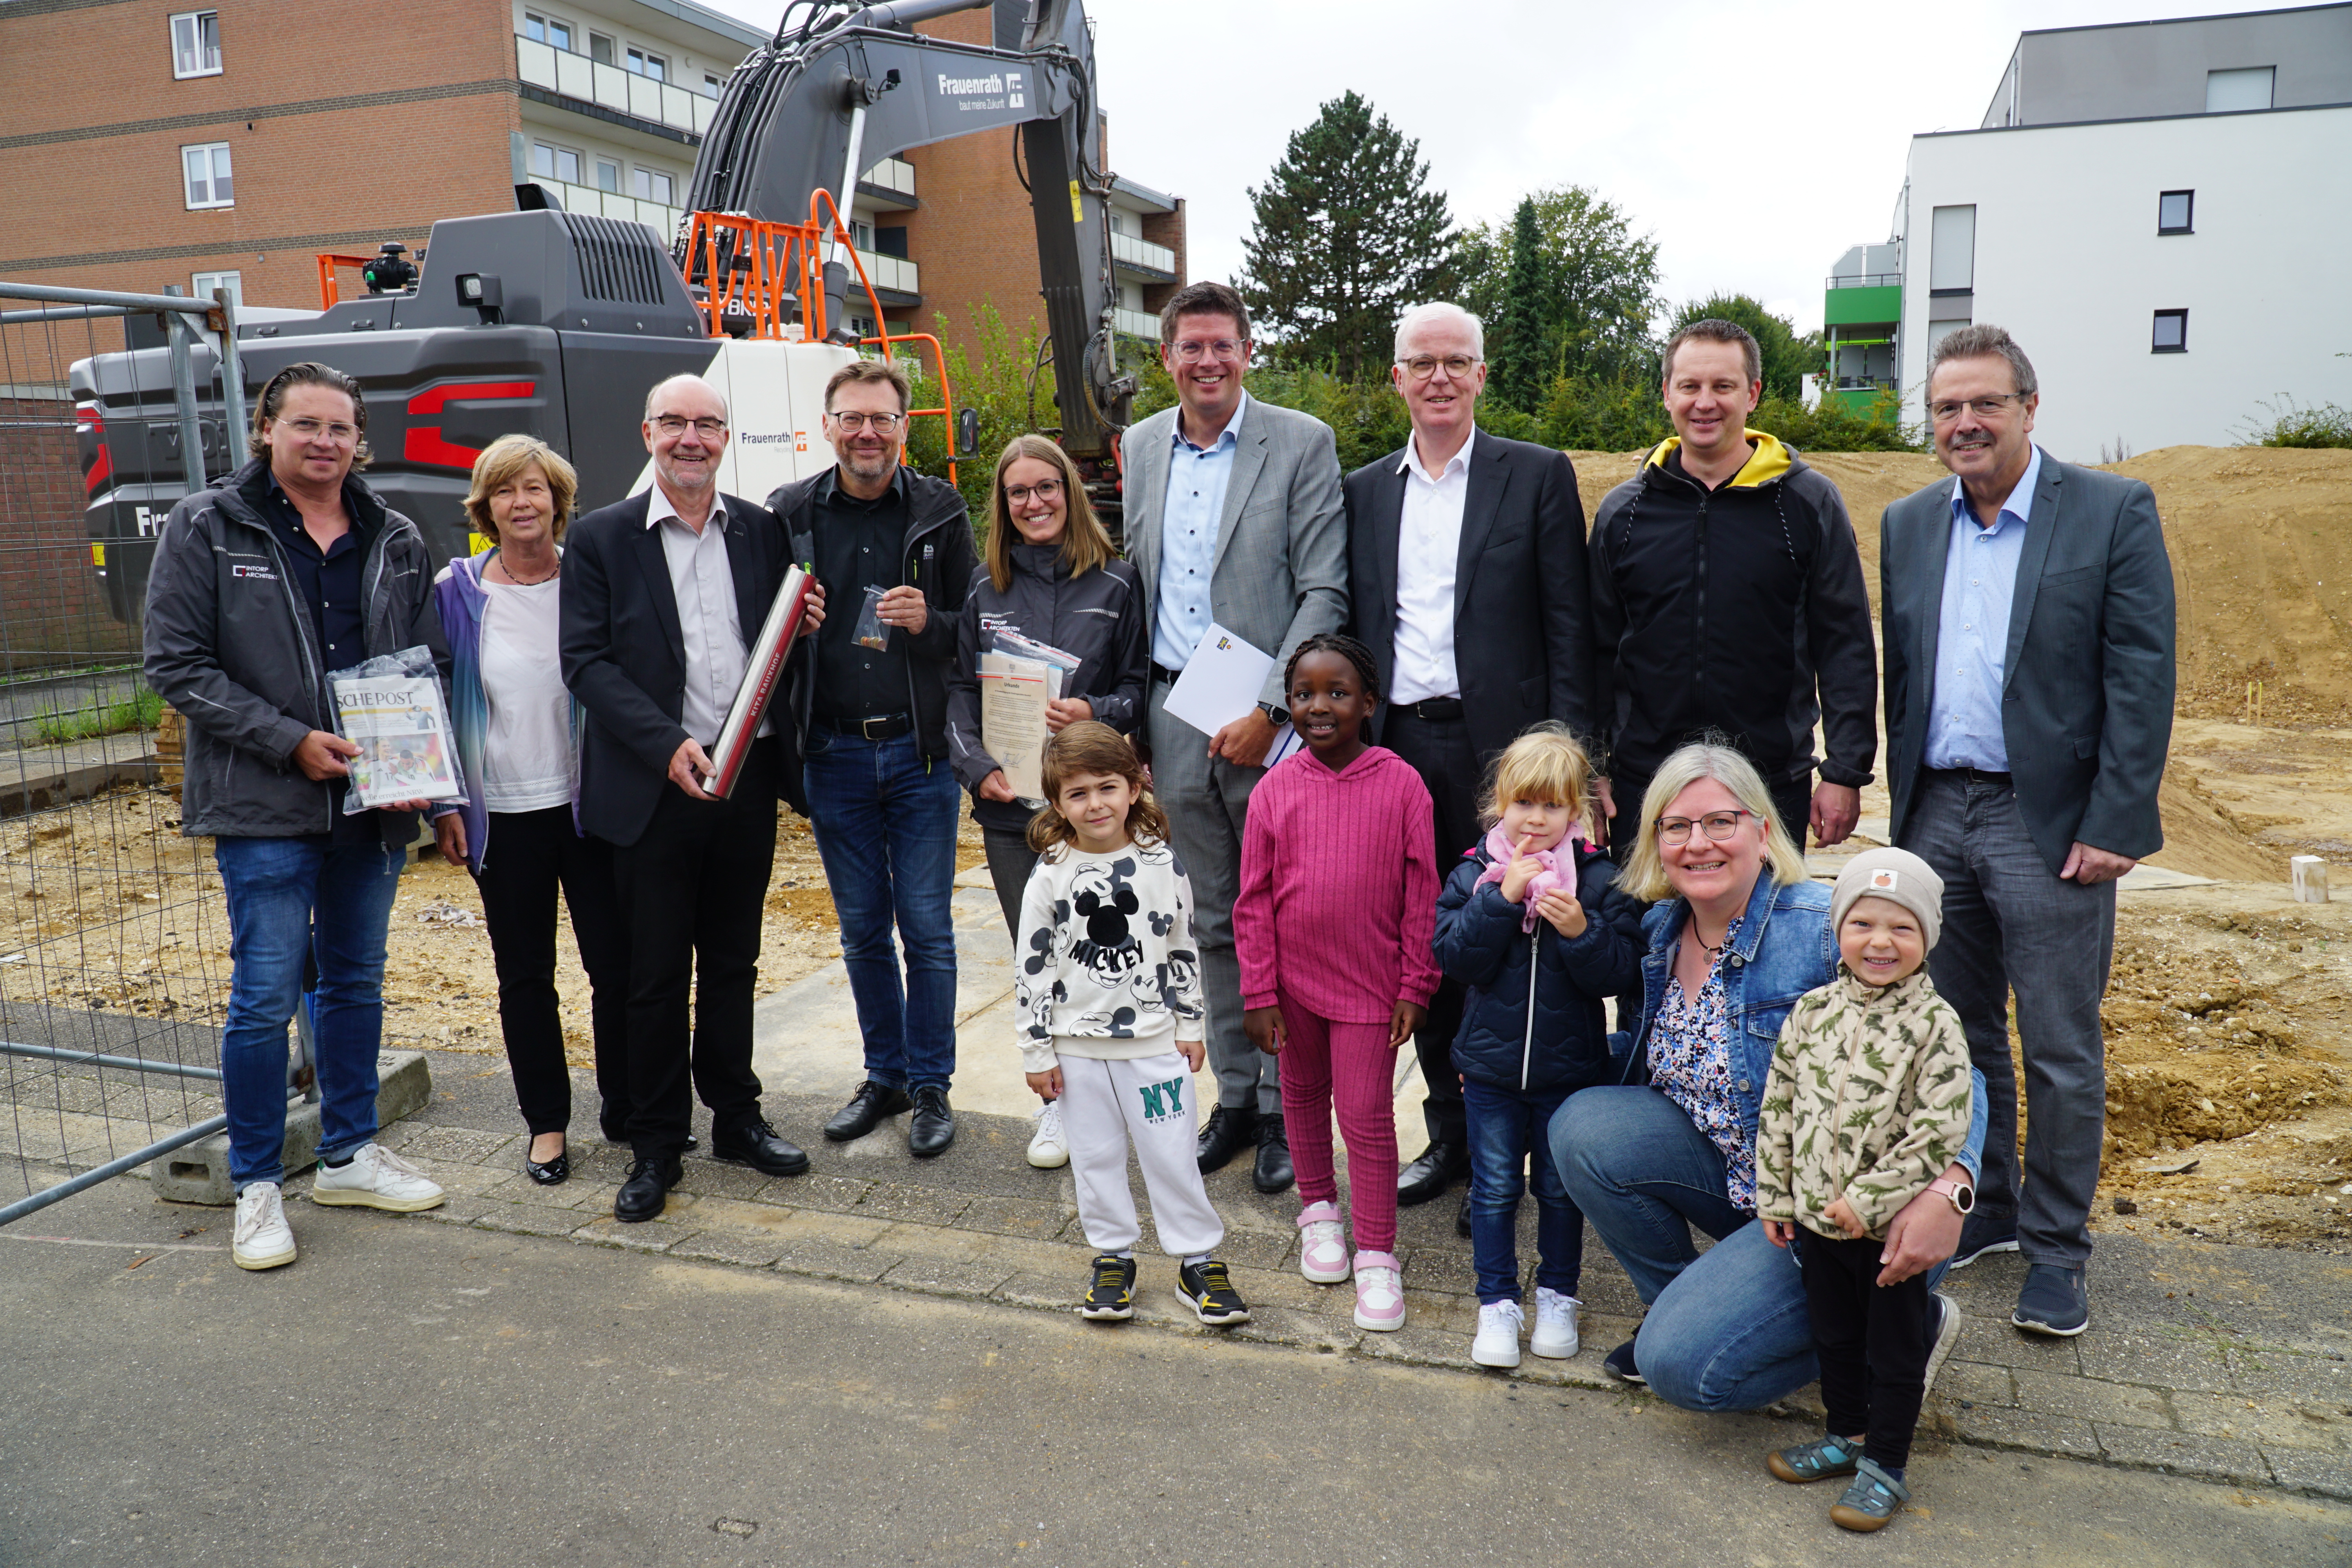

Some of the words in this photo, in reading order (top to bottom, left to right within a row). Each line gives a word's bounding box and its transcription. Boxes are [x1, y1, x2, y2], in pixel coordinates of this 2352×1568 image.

[938, 74, 1003, 94] Frauenrath
[959, 100, 971, 111] baut
[972, 100, 986, 110] meine
[987, 98, 1005, 109] Zukunft
[703, 297, 769, 317] BRI
[742, 432, 791, 444] Frauenrath
[135, 507, 168, 536] Fr
[750, 697, 763, 717] KITA
[760, 652, 780, 694] BAUXHOF
[375, 692, 413, 705] POST
[1068, 940, 1144, 972] MICKEY
[1139, 1076, 1183, 1118] NY
[1168, 1110, 1186, 1120] YORK
